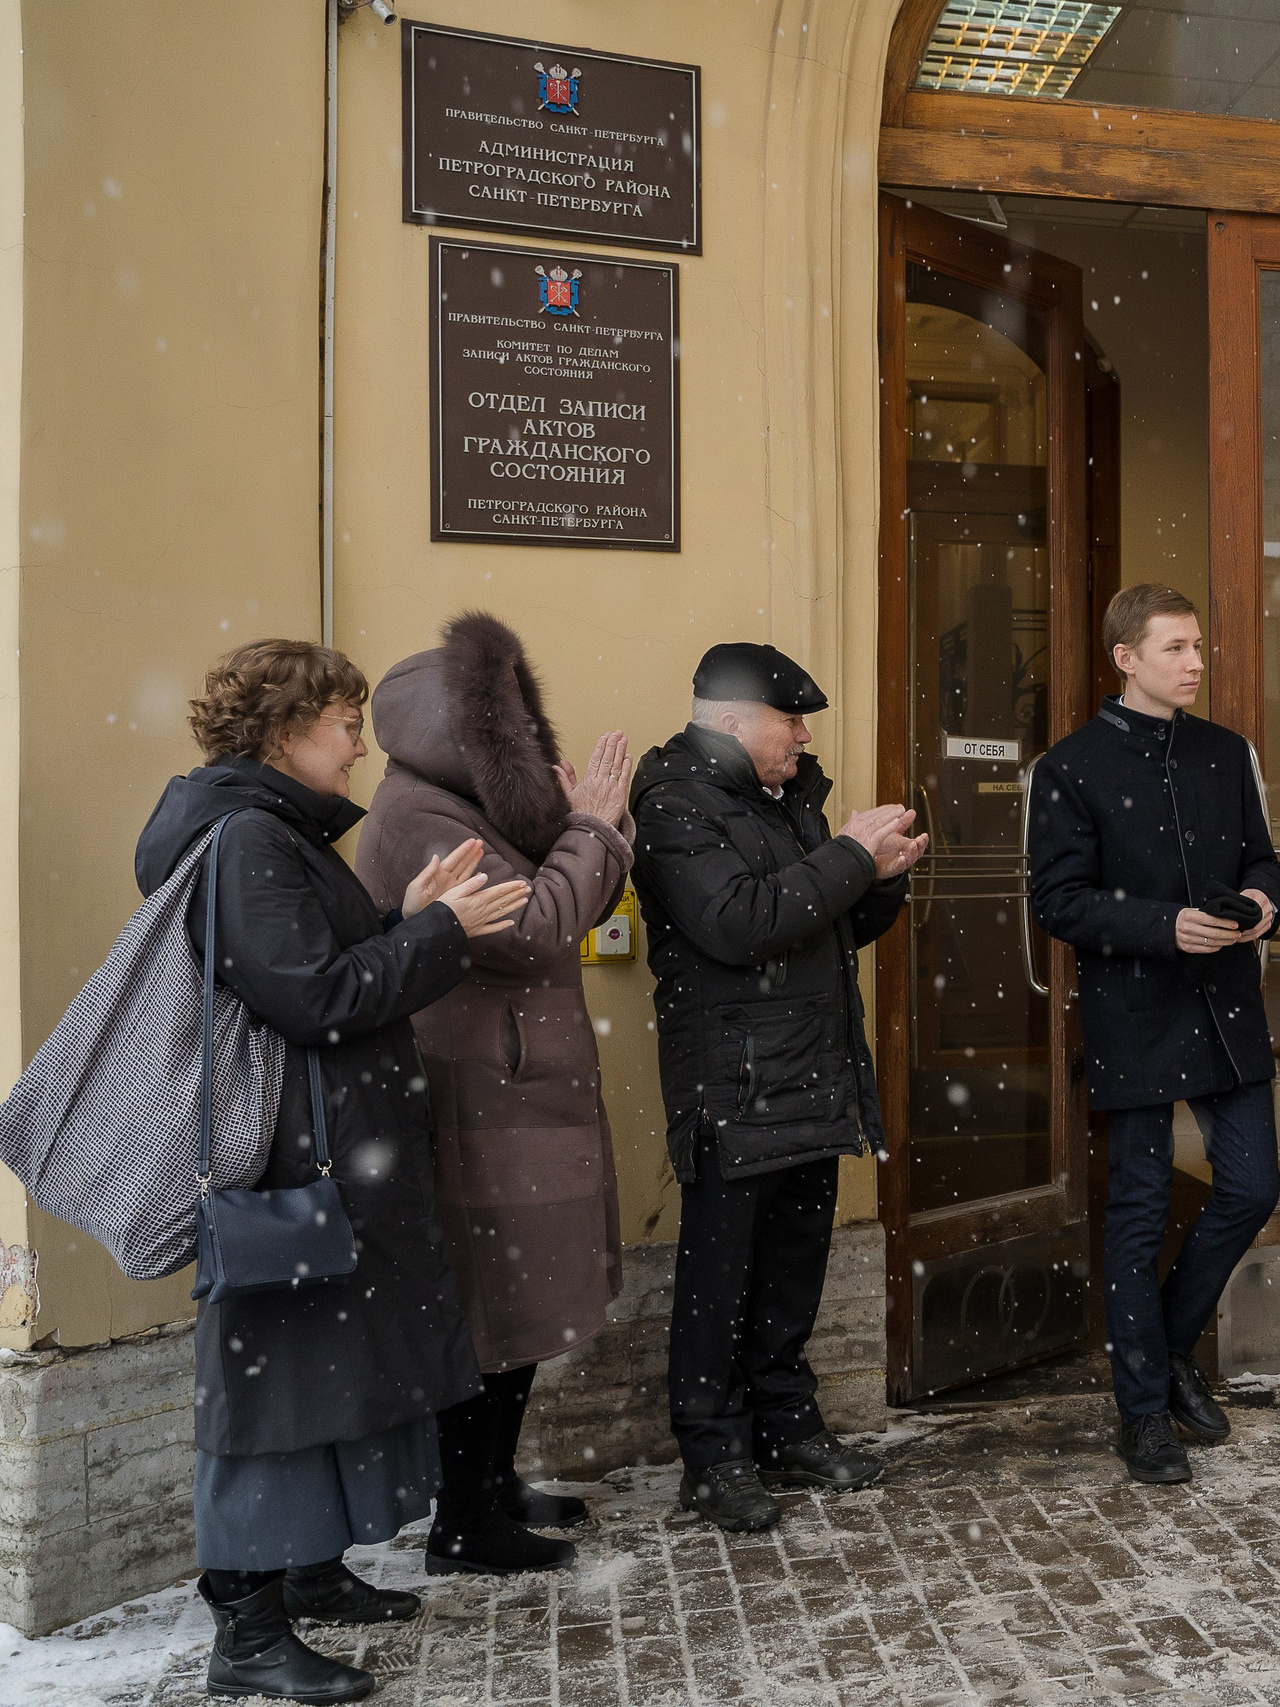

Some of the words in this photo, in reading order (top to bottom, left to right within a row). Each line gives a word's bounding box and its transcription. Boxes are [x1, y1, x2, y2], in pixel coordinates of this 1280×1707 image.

[445, 108, 544, 130] ПРАВИТЕЛЬСТВО
[550, 124, 664, 146] САНКТ-ПЕТЕРБУРГА
[479, 141, 634, 172] АДМИНИСТРАЦИЯ
[438, 158, 596, 189] ПЕТРОГРАДСКОГО
[606, 178, 671, 198] РАЙОНА
[469, 185, 644, 217] САНКТ-ПЕТЕРБУРГА
[448, 312, 546, 330] ПРАВИТЕЛЬСТВО
[553, 322, 664, 341] САНКТ-ПЕТЕРБУРГА
[462, 349, 510, 361] ЗАПИСИ
[515, 354, 554, 365] АКТОВ
[558, 356, 651, 374] ГРАЖДАНСКОГО
[497, 340, 550, 353] КОМИТЕТ
[557, 346, 573, 354] ПО
[578, 346, 619, 359] ДЕЛАМ
[524, 366, 594, 380] СОСТОЯНИЯ
[468, 392, 546, 414] ОТДЕЛ
[559, 399, 646, 421] ЗАПИСИ
[522, 419, 596, 439] АКТОВ
[463, 436, 651, 465] ГРАЖДАНСКОГО
[490, 462, 626, 485] СОСТОЯНИЯ
[468, 498, 588, 514] ПЕТРОГРАДСКОГО
[596, 504, 648, 518] РАЙОНА
[492, 514, 624, 530] САНКТ-ПЕТЕРБУРГА
[964, 743, 977, 754] ОТ
[980, 744, 1005, 756] СЕБЯ
[992, 784, 1004, 792] НА
[1006, 784, 1024, 792] СЕБ
